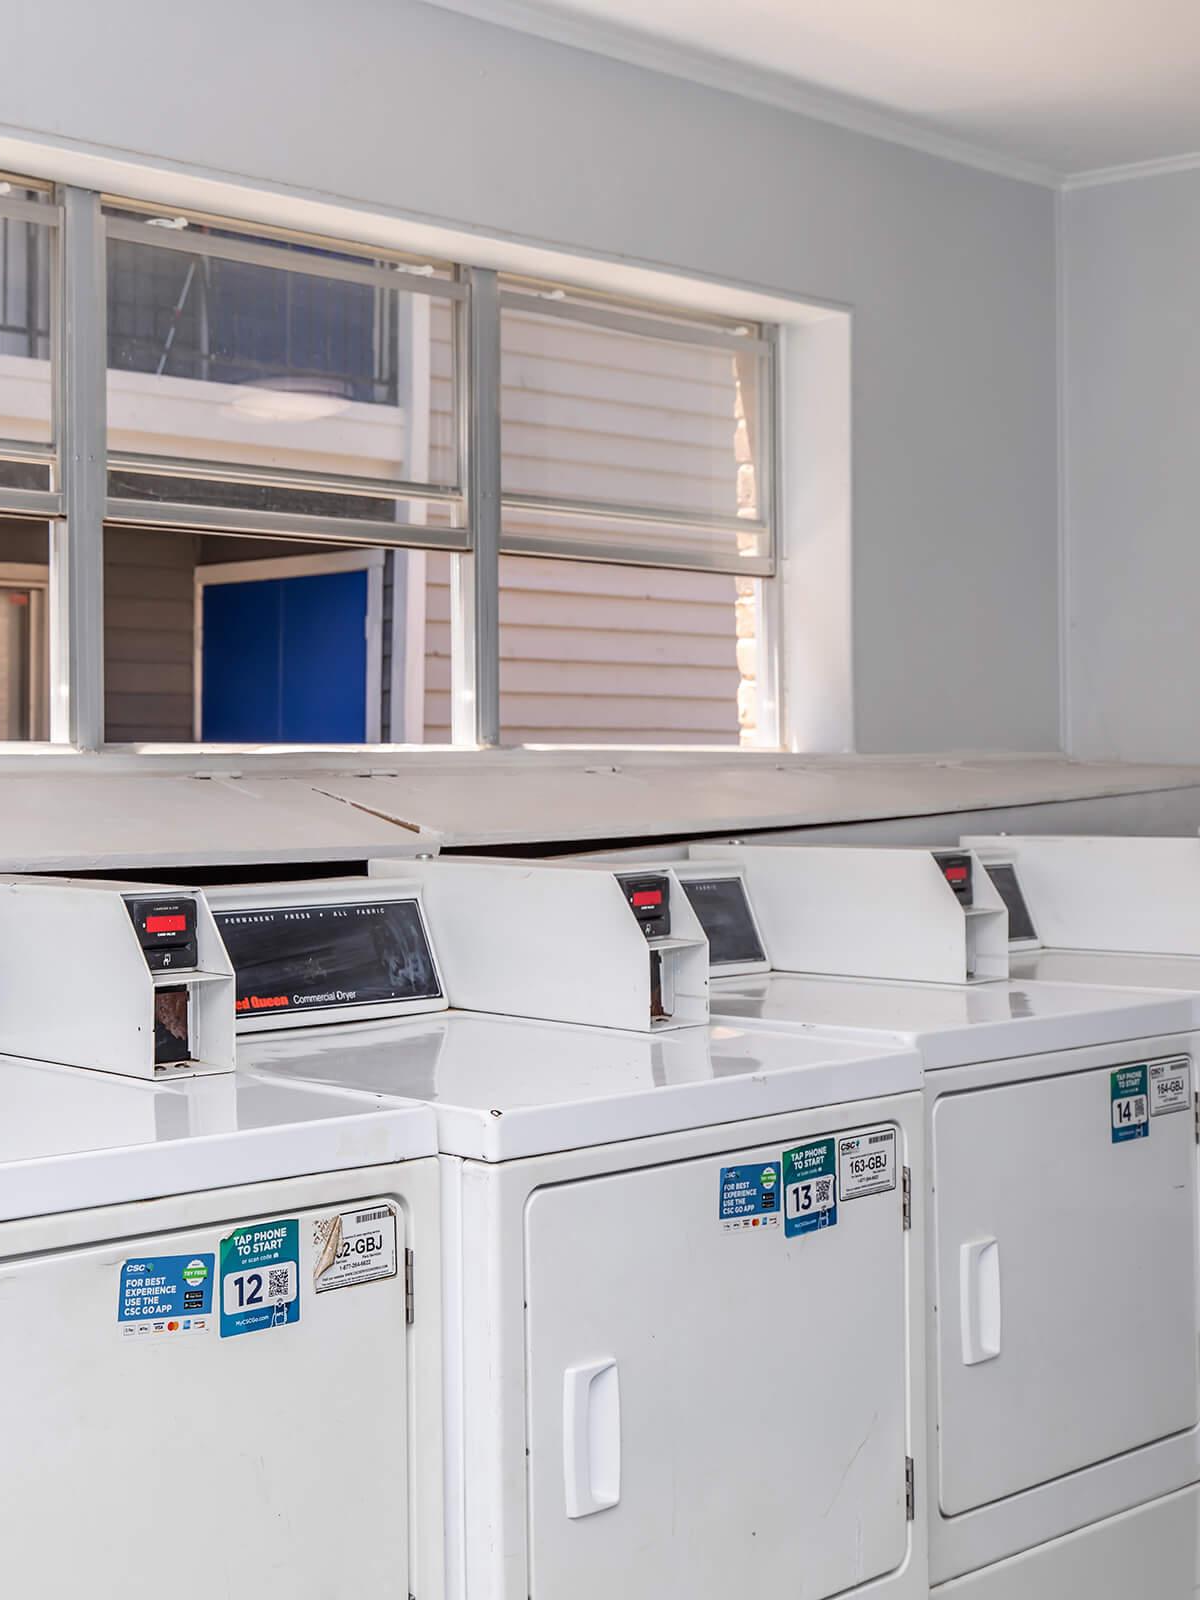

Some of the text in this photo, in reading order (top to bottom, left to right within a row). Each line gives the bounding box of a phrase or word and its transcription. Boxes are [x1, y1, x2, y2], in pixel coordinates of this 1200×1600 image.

[224, 914, 275, 924] PERMANENT
[284, 912, 311, 920] PRESS
[356, 907, 385, 915] FABRIC
[251, 996, 289, 1009] Queen
[293, 991, 335, 1004] Commercial
[336, 990, 357, 1001] Dryer
[1116, 1101, 1131, 1123] 14
[791, 1146, 827, 1161] TAP PHONE
[841, 1141, 855, 1151] CSC
[794, 1155, 824, 1170] TO START
[850, 1154, 887, 1174] 163-GBJ
[724, 1181, 750, 1191] FOR BEST
[723, 1188, 757, 1200] EXPERIENCE
[792, 1184, 812, 1212] 13
[723, 1197, 746, 1207] USE THE
[723, 1207, 734, 1215] CSC
[743, 1204, 755, 1212] APP
[233, 1227, 287, 1246] TAP PHONE
[237, 1239, 283, 1256] TO START
[336, 1234, 382, 1259] 2-GBJ
[126, 1264, 145, 1272] CSC
[126, 1277, 166, 1288] FOR BEST
[125, 1285, 177, 1297] EXPERIENCE
[233, 1274, 263, 1307] 12
[124, 1296, 159, 1306] USE THE
[124, 1304, 173, 1316] CSC GO APP
